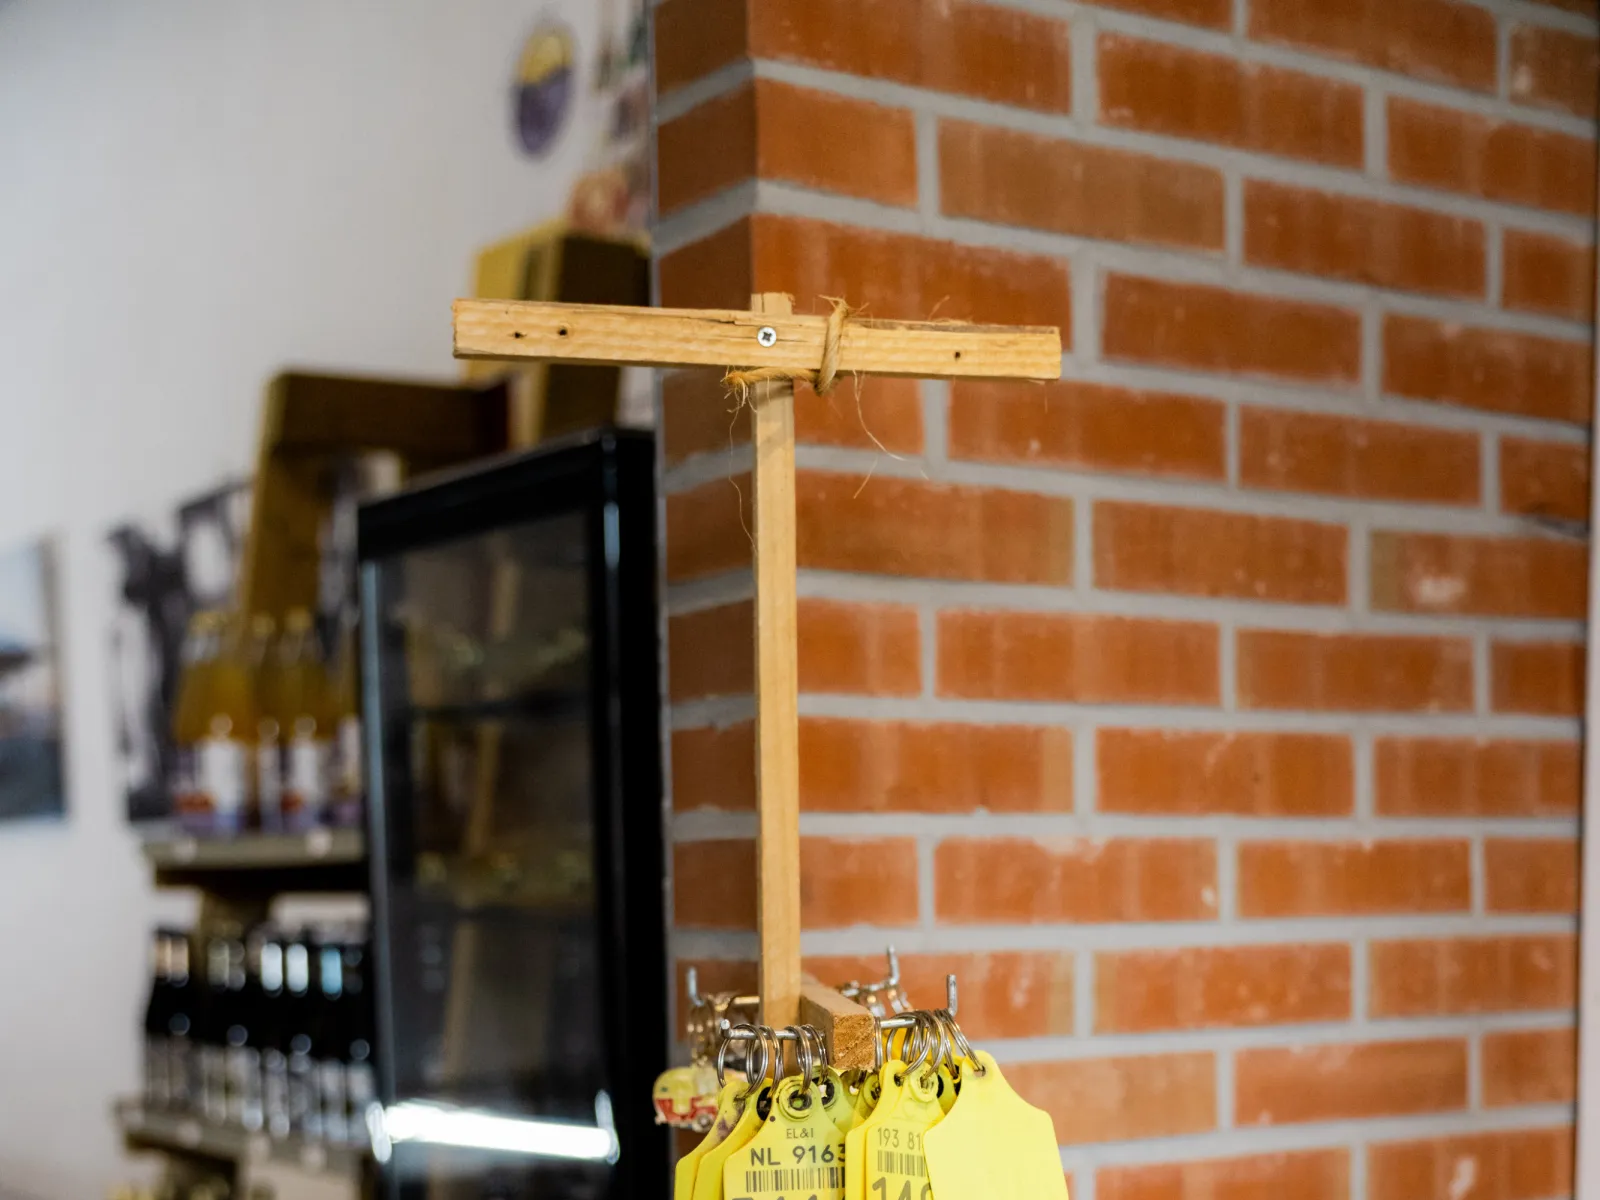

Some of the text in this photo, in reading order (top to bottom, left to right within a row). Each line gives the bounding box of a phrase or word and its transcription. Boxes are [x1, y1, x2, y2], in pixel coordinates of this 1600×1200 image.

[786, 1128, 814, 1139] EL&I
[878, 1127, 921, 1151] 193 81
[751, 1143, 845, 1166] NL 9163
